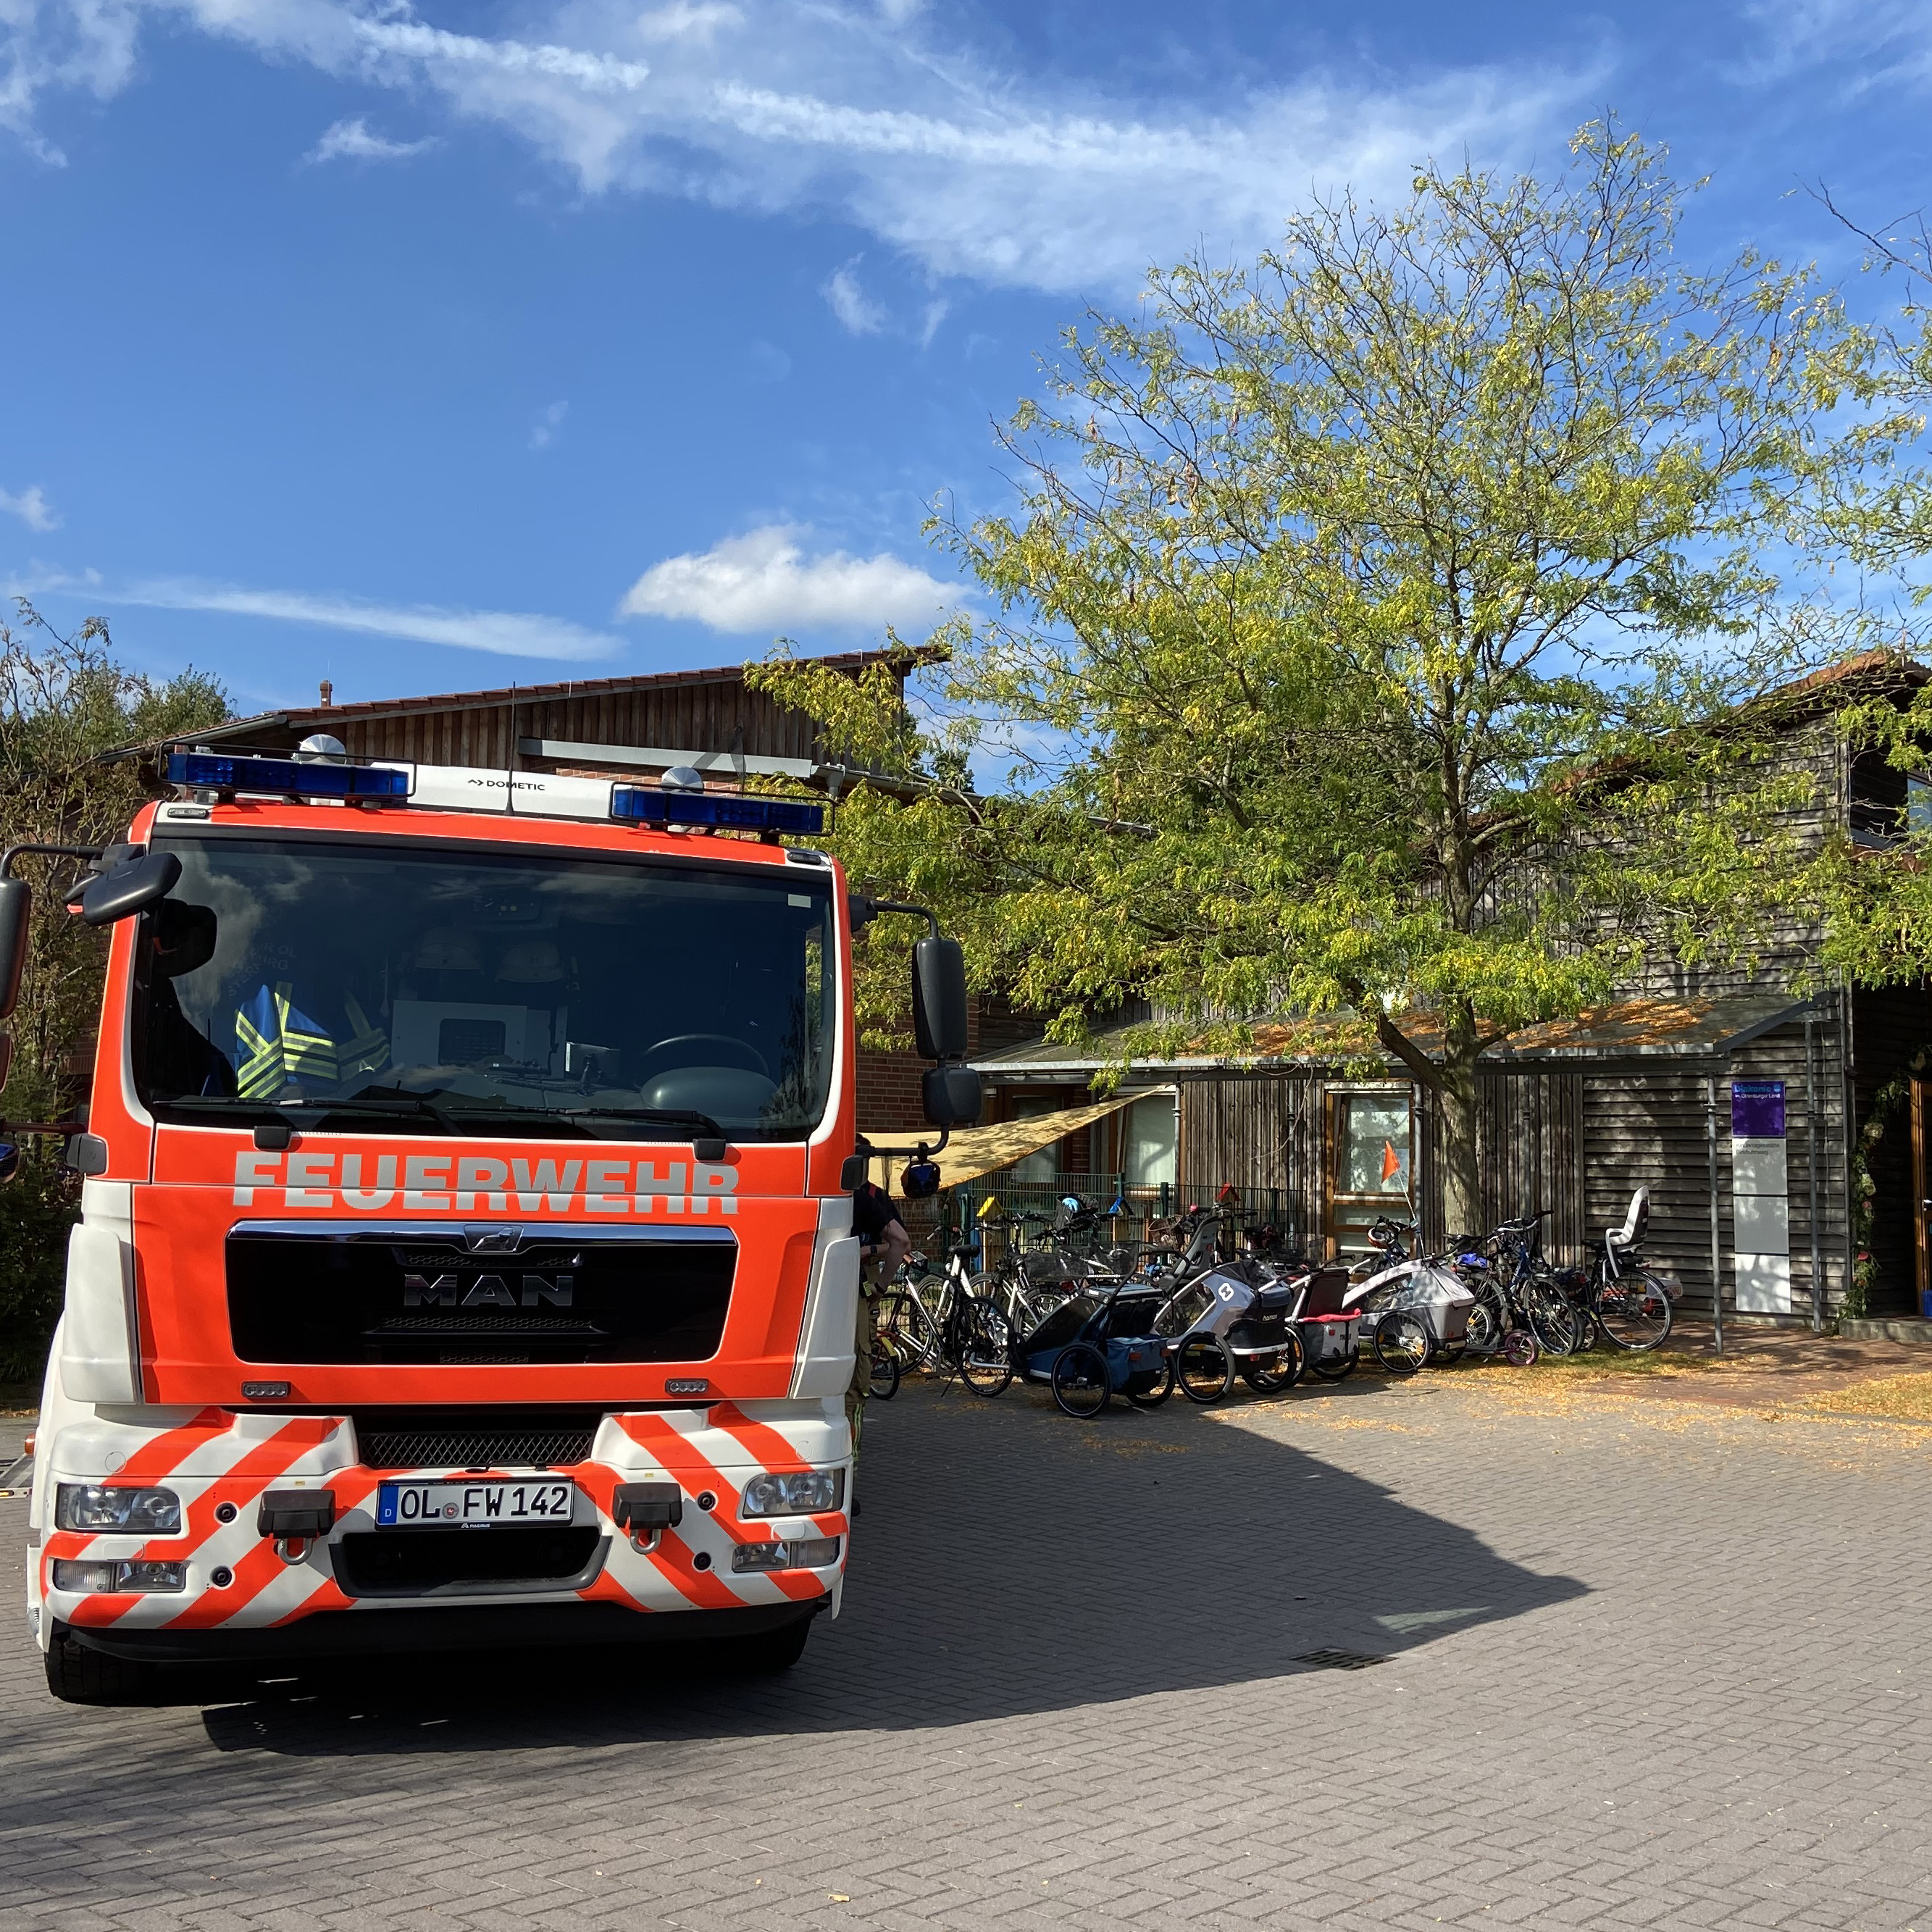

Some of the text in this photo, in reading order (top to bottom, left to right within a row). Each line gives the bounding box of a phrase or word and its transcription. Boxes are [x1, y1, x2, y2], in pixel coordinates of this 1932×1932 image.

[487, 781, 545, 790] DOMETIC
[233, 1151, 739, 1214] FEUERWEHR
[404, 1274, 572, 1305] MAN
[385, 1508, 392, 1518] D
[401, 1486, 567, 1519] OL FW 142
